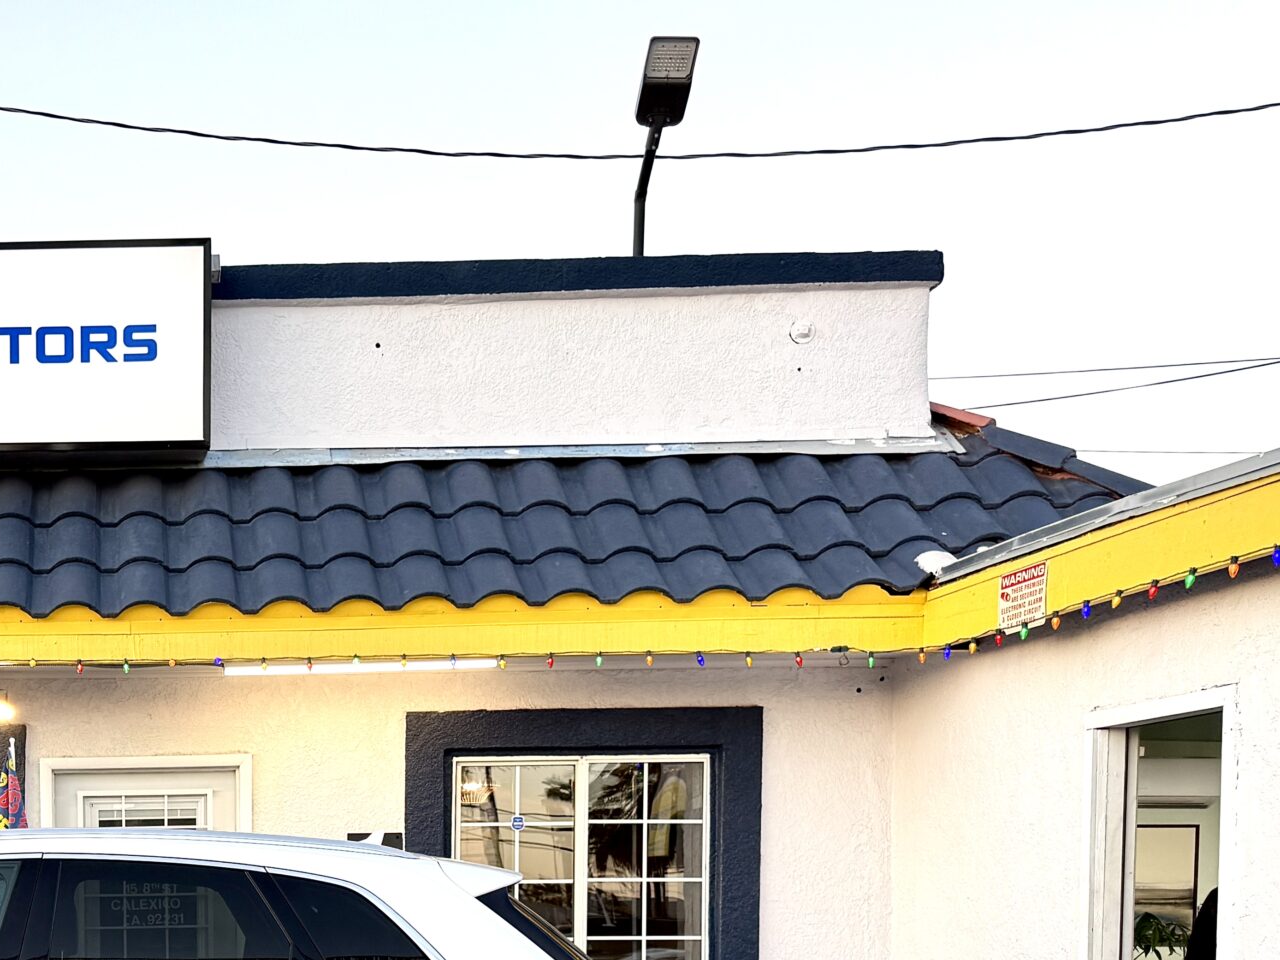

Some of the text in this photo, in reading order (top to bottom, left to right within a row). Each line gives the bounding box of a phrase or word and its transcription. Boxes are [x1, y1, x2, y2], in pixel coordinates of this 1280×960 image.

[1002, 564, 1045, 588] WARNING
[1024, 578, 1044, 591] PREMISES
[1019, 590, 1037, 601] SECURED
[1001, 596, 1043, 615] ELECTRONIC ALARM
[1006, 611, 1022, 622] CLOSED
[1023, 605, 1041, 616] CIRCUIT
[111, 897, 181, 911] CALEXICO
